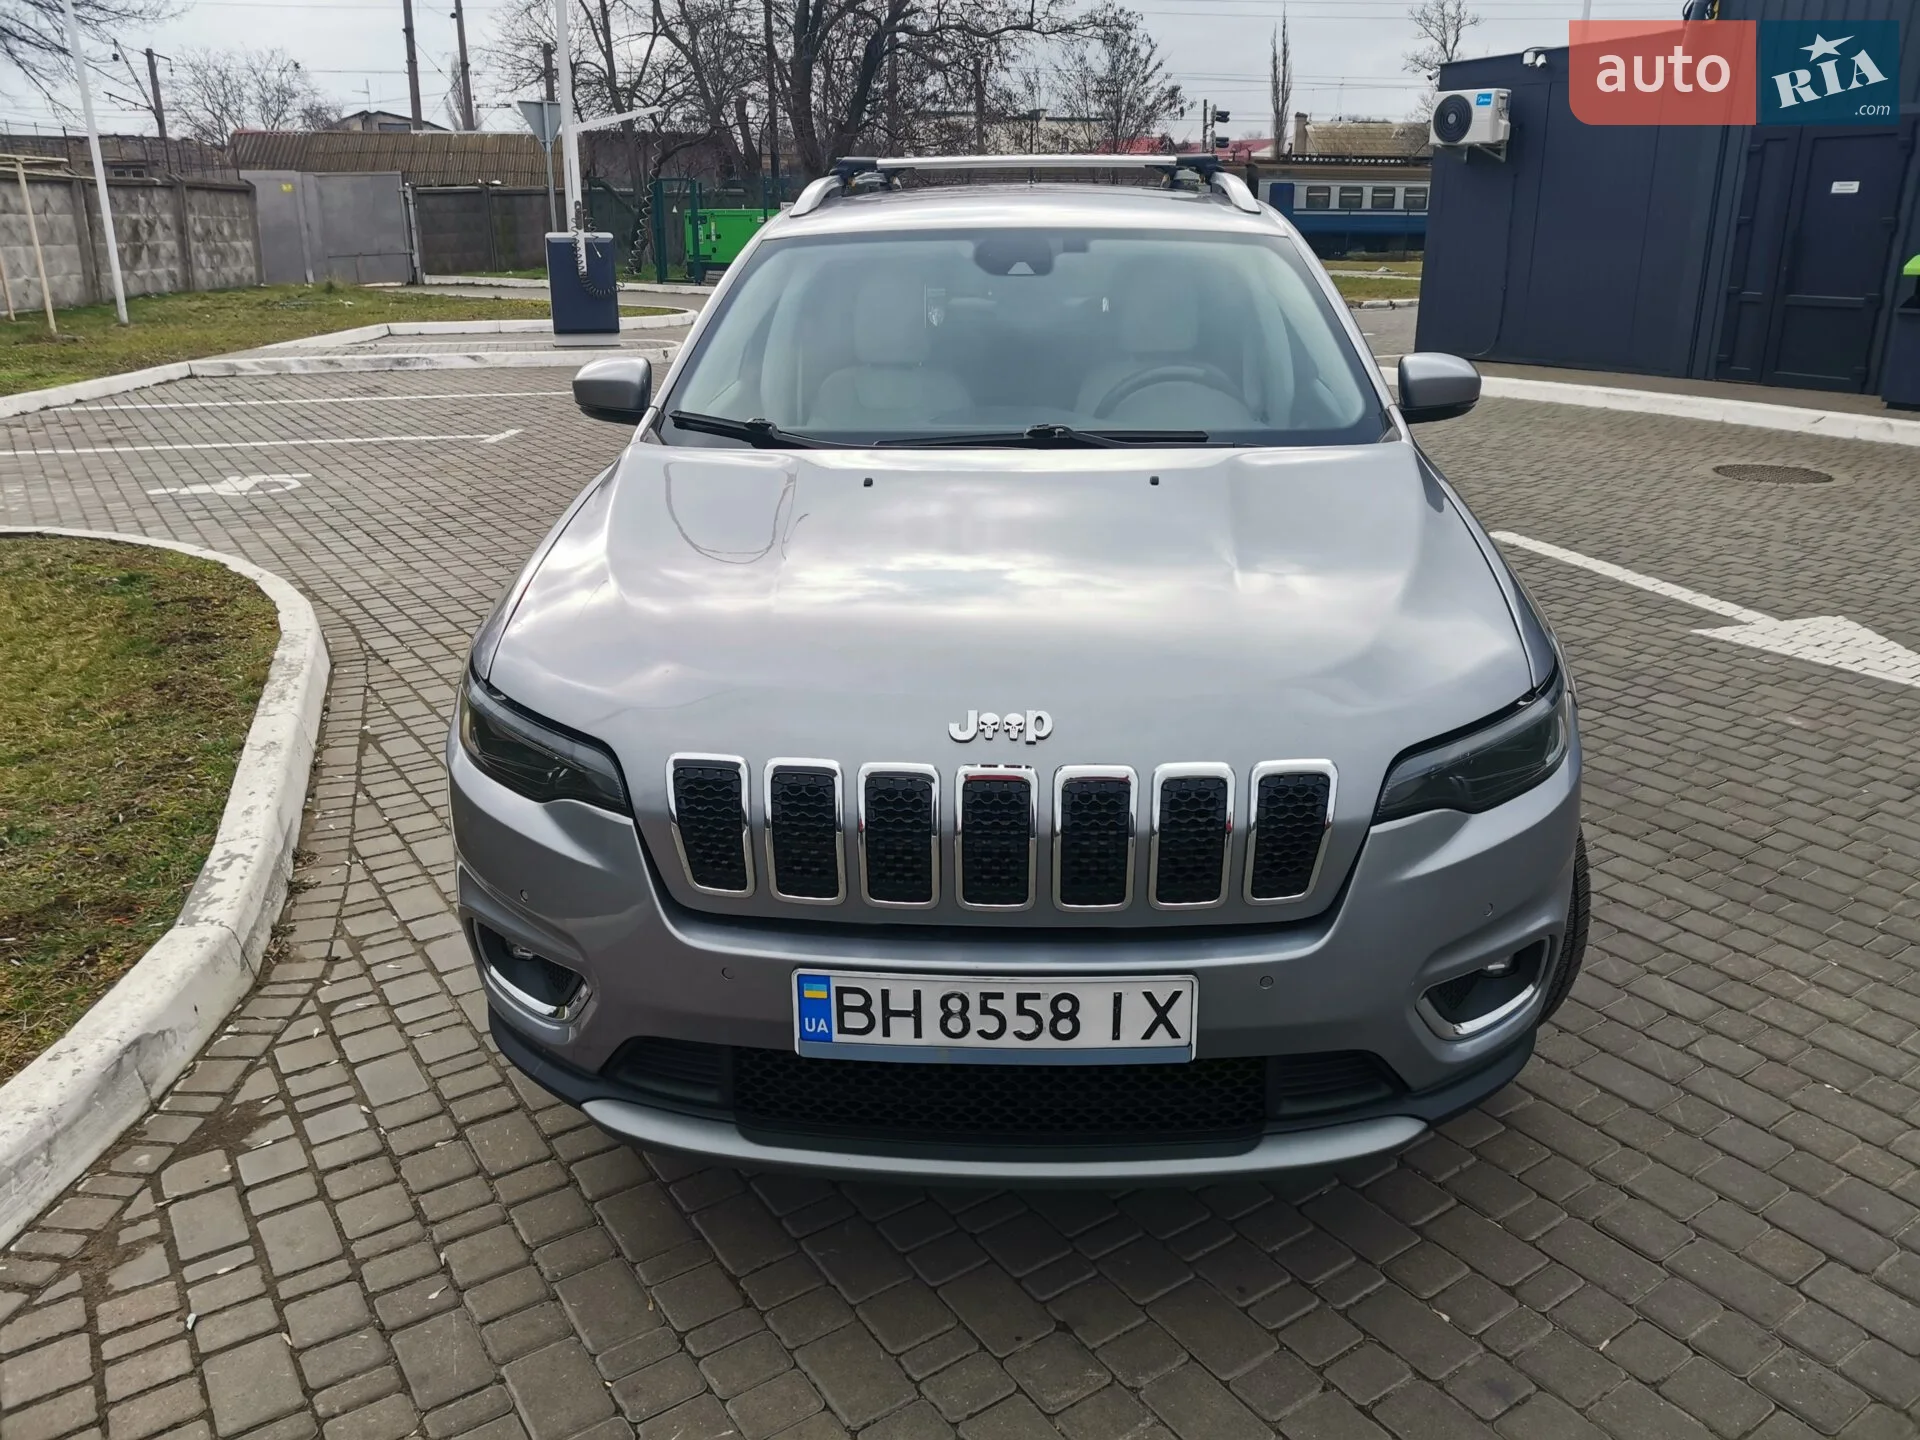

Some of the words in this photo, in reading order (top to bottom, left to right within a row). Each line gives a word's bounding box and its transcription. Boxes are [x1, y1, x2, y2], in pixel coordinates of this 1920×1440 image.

[948, 710, 1053, 744] Jp
[805, 1017, 829, 1034] UA
[834, 985, 923, 1040] BH
[938, 990, 1081, 1042] 8558
[1110, 990, 1183, 1041] IX
